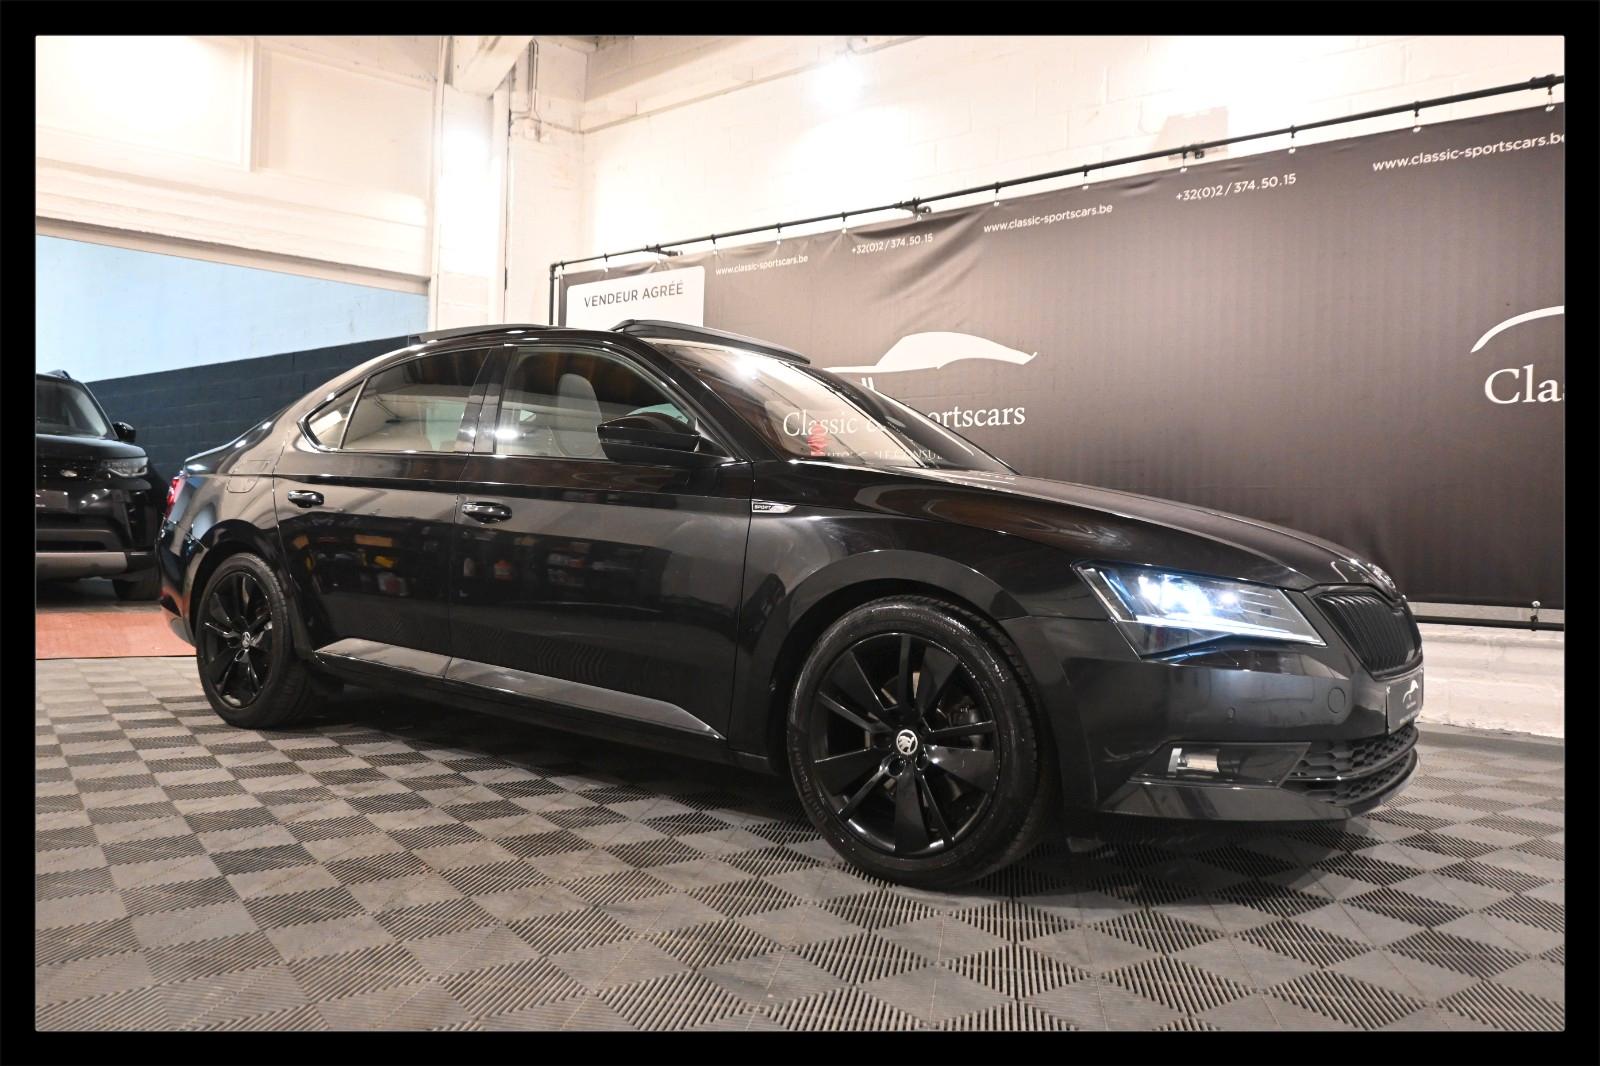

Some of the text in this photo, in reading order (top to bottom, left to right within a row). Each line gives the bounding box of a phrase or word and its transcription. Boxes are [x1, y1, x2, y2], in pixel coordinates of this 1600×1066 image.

[983, 203, 1113, 233] www.classic-sportscars.be
[715, 254, 809, 275] www.classic-sportscars.be
[584, 280, 684, 308] VENDEUR AGRÉÉ
[1484, 363, 1565, 404] Cla
[927, 406, 1026, 428] ortscars
